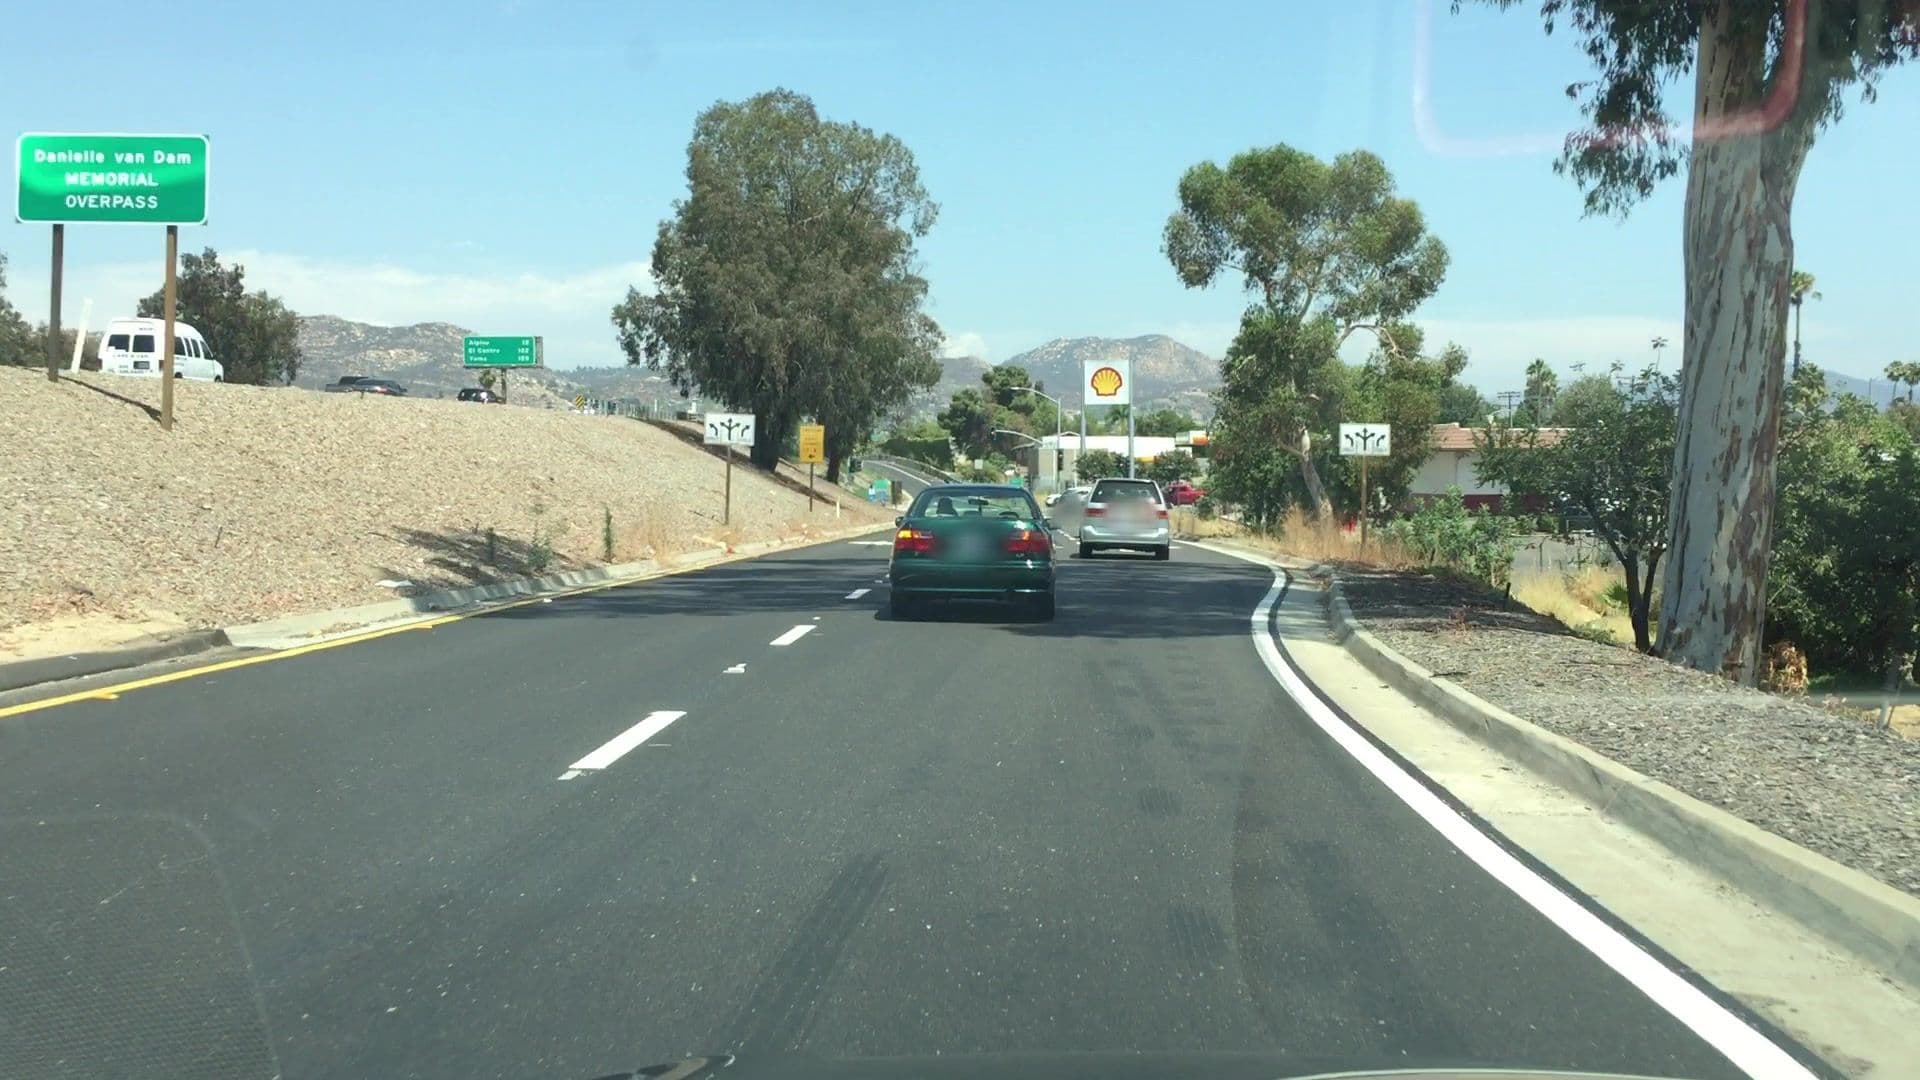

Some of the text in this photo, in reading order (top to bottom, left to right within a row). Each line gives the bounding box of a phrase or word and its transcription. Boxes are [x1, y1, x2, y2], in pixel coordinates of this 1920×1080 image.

[34, 149, 192, 165] Danielle van Dam
[64, 172, 159, 187] MEMORIAL
[65, 194, 158, 209] OVERPASS
